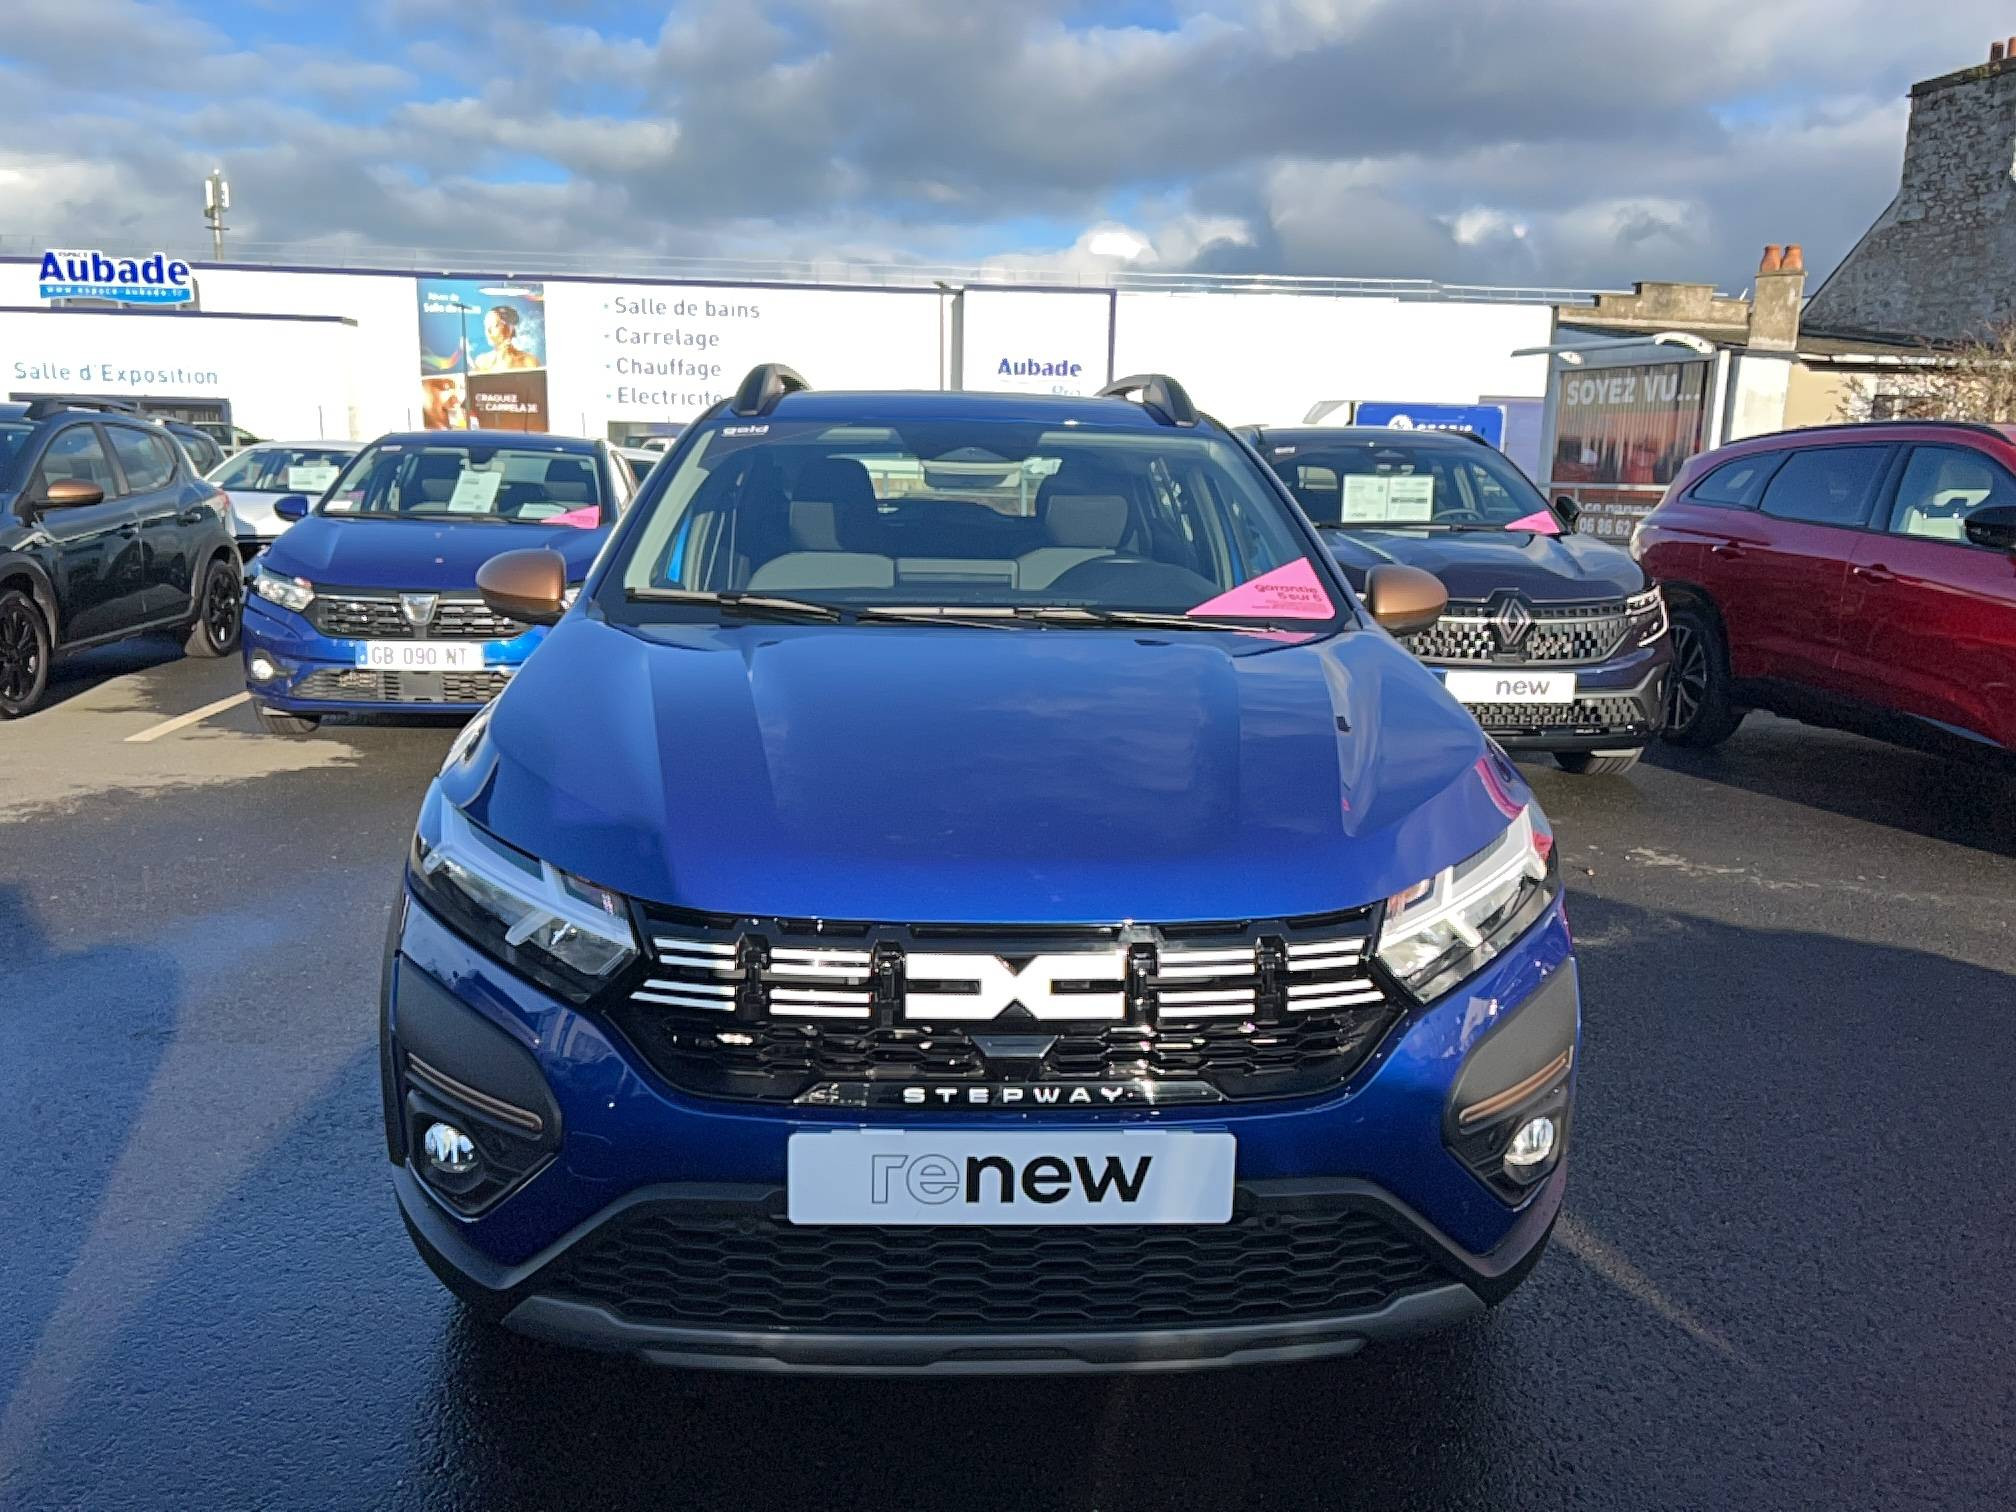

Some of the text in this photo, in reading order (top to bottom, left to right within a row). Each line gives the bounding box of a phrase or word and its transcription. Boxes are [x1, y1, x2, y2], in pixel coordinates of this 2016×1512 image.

[40, 251, 189, 285] Aubade
[615, 296, 760, 319] Salle de bains
[615, 326, 720, 351] Carrelage
[14, 361, 218, 386] Salle d'Exposition
[616, 356, 722, 381] Chauffage
[997, 357, 1083, 377] Aubade
[1567, 376, 1636, 405] SOYEZ
[371, 646, 467, 665] GB 090 NT
[1495, 679, 1551, 696] new
[903, 1087, 1124, 1104] STEPWAY
[871, 1154, 1152, 1205] renew
